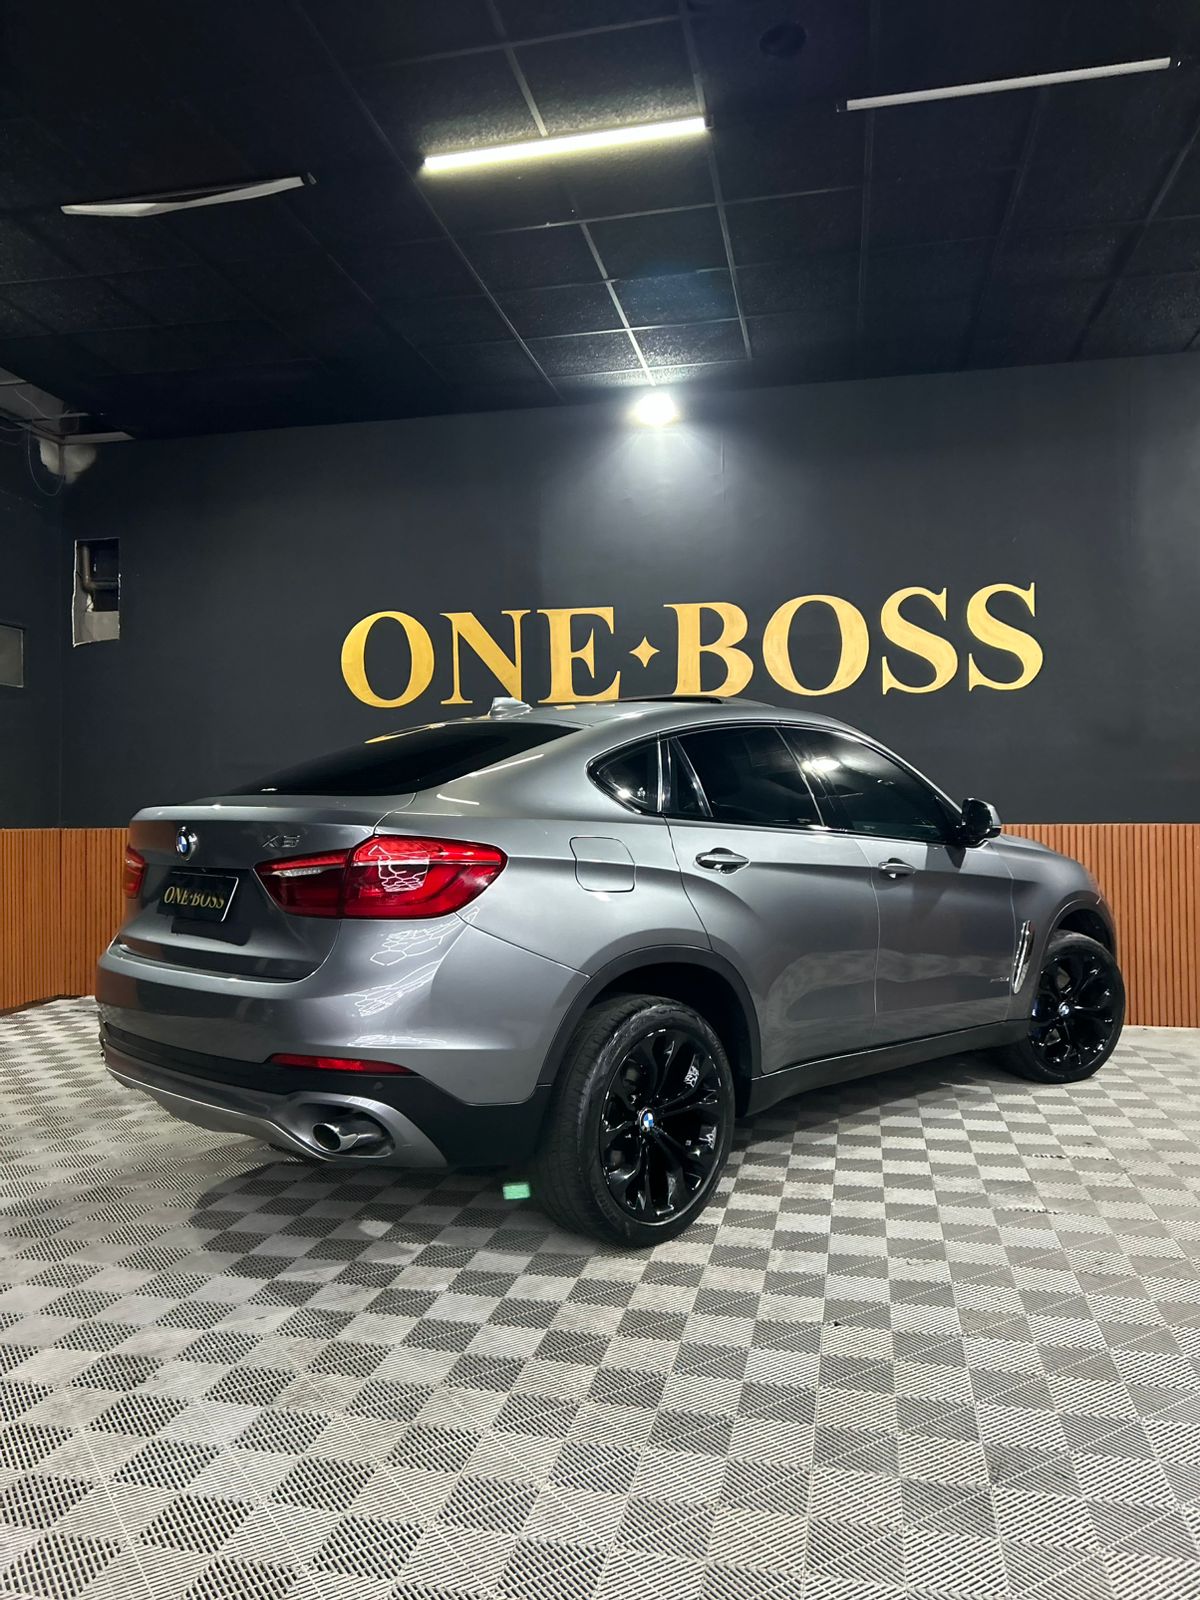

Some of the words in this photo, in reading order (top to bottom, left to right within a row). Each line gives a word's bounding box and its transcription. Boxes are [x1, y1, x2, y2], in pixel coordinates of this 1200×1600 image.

[340, 606, 621, 709] ONE
[663, 582, 1044, 699] BOSS
[164, 887, 190, 906] ONE
[191, 891, 225, 909] BOSS
